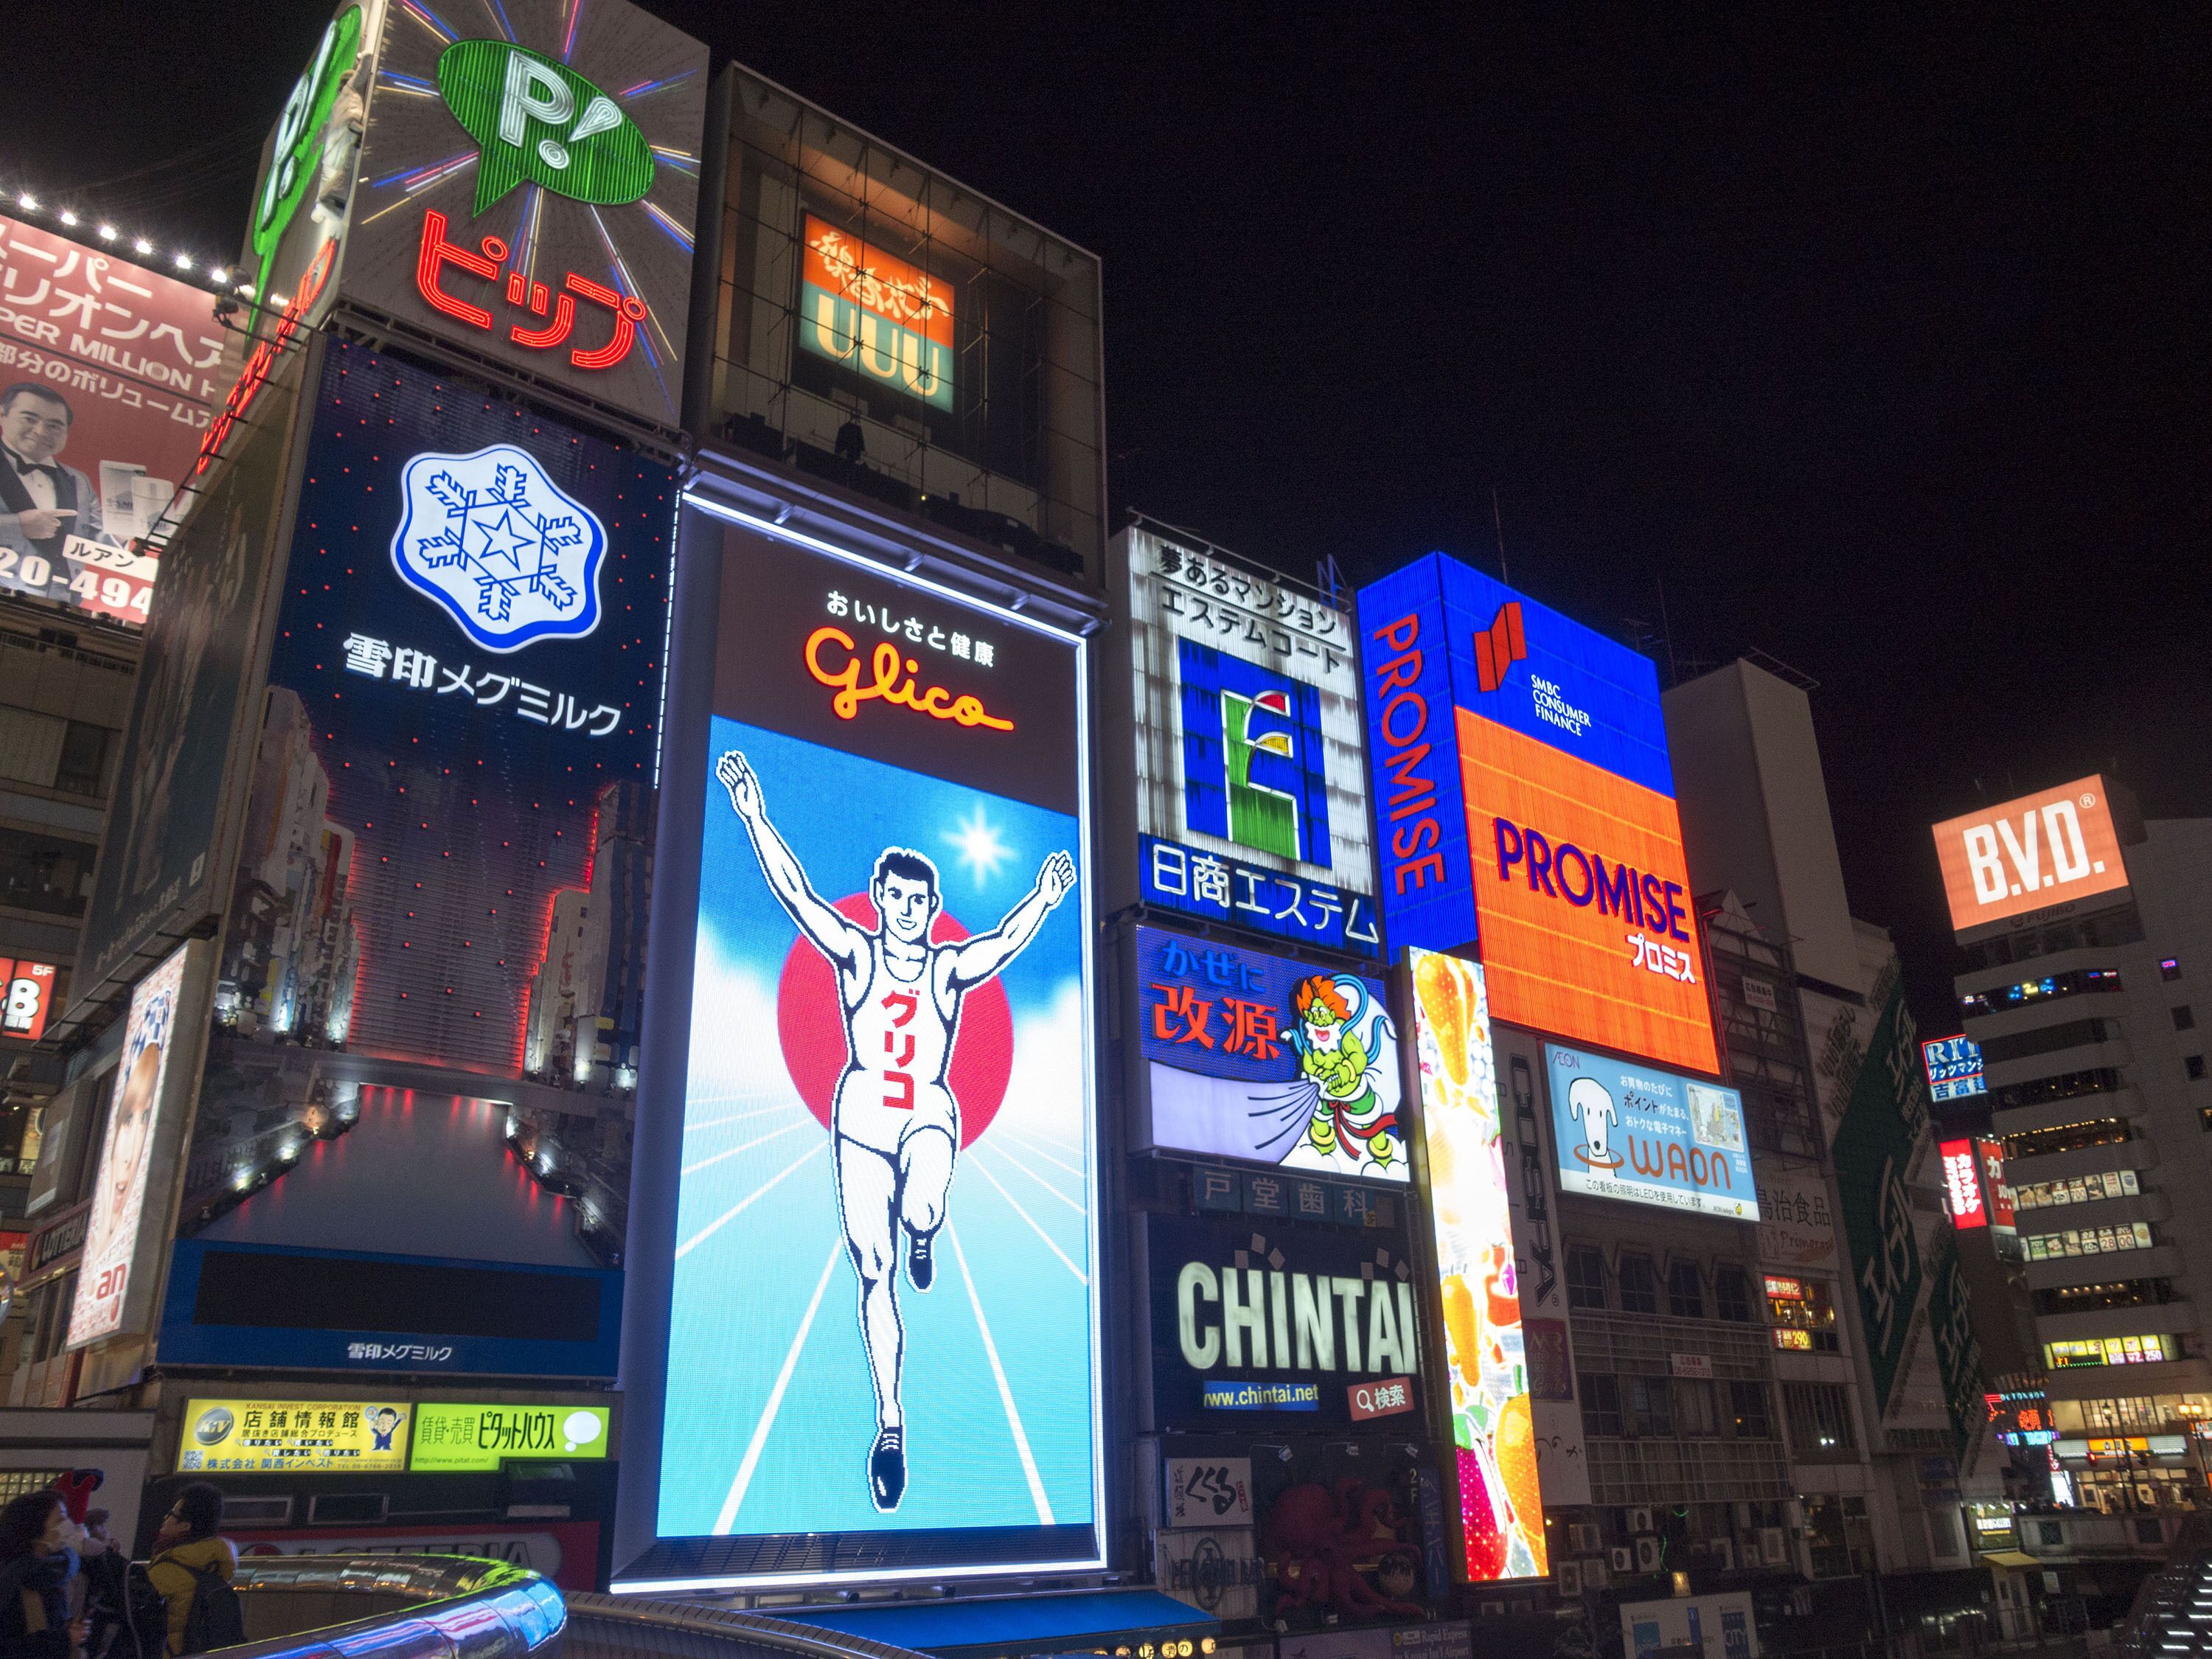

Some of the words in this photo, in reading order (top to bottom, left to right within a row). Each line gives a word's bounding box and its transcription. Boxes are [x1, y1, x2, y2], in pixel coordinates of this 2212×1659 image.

[0, 223, 153, 299] ーパー
[417, 209, 647, 369] ピップ
[0, 263, 223, 369] リオンヘア
[70, 333, 192, 392] MILLION
[70, 542, 134, 568] ルアン
[1159, 546, 1336, 636] 夢あるマンション
[827, 591, 994, 667] おいしさと健康
[1161, 585, 1340, 675] エステムコート
[343, 632, 622, 737] 雪印メグミルク
[804, 626, 1015, 731] Glico
[1531, 674, 1560, 699] SMBC
[1533, 688, 1591, 728] CONSUMER
[1535, 706, 1582, 737] FINANCE
[1374, 613, 1445, 896] PROMISE
[1494, 817, 1690, 944] PROMISE
[1963, 800, 2106, 905] B.V.D.
[1153, 844, 1380, 944] 日商エステム
[1161, 939, 1267, 992] かぜに
[1625, 933, 1696, 984] プロミス
[881, 989, 920, 1110] グリコ
[1151, 982, 1282, 1062] 改源
[1620, 1075, 1674, 1098] お買物のたびに
[1628, 1134, 1732, 1190] WAON
[1956, 1153, 1981, 1214] カラオケ
[96, 1263, 127, 1301] an
[1178, 1261, 1417, 1374] CHINTAI
[347, 1343, 453, 1361] 雪印メグミルク
[244, 1411, 360, 1428] 店舗情報館
[1374, 1384, 1406, 1410] 検索
[479, 1411, 555, 1450] ピタットハウス
[207, 1458, 255, 1469] 株式会社
[261, 1458, 333, 1470] 関西インベスト
[1185, 1467, 1237, 1515] くくる
